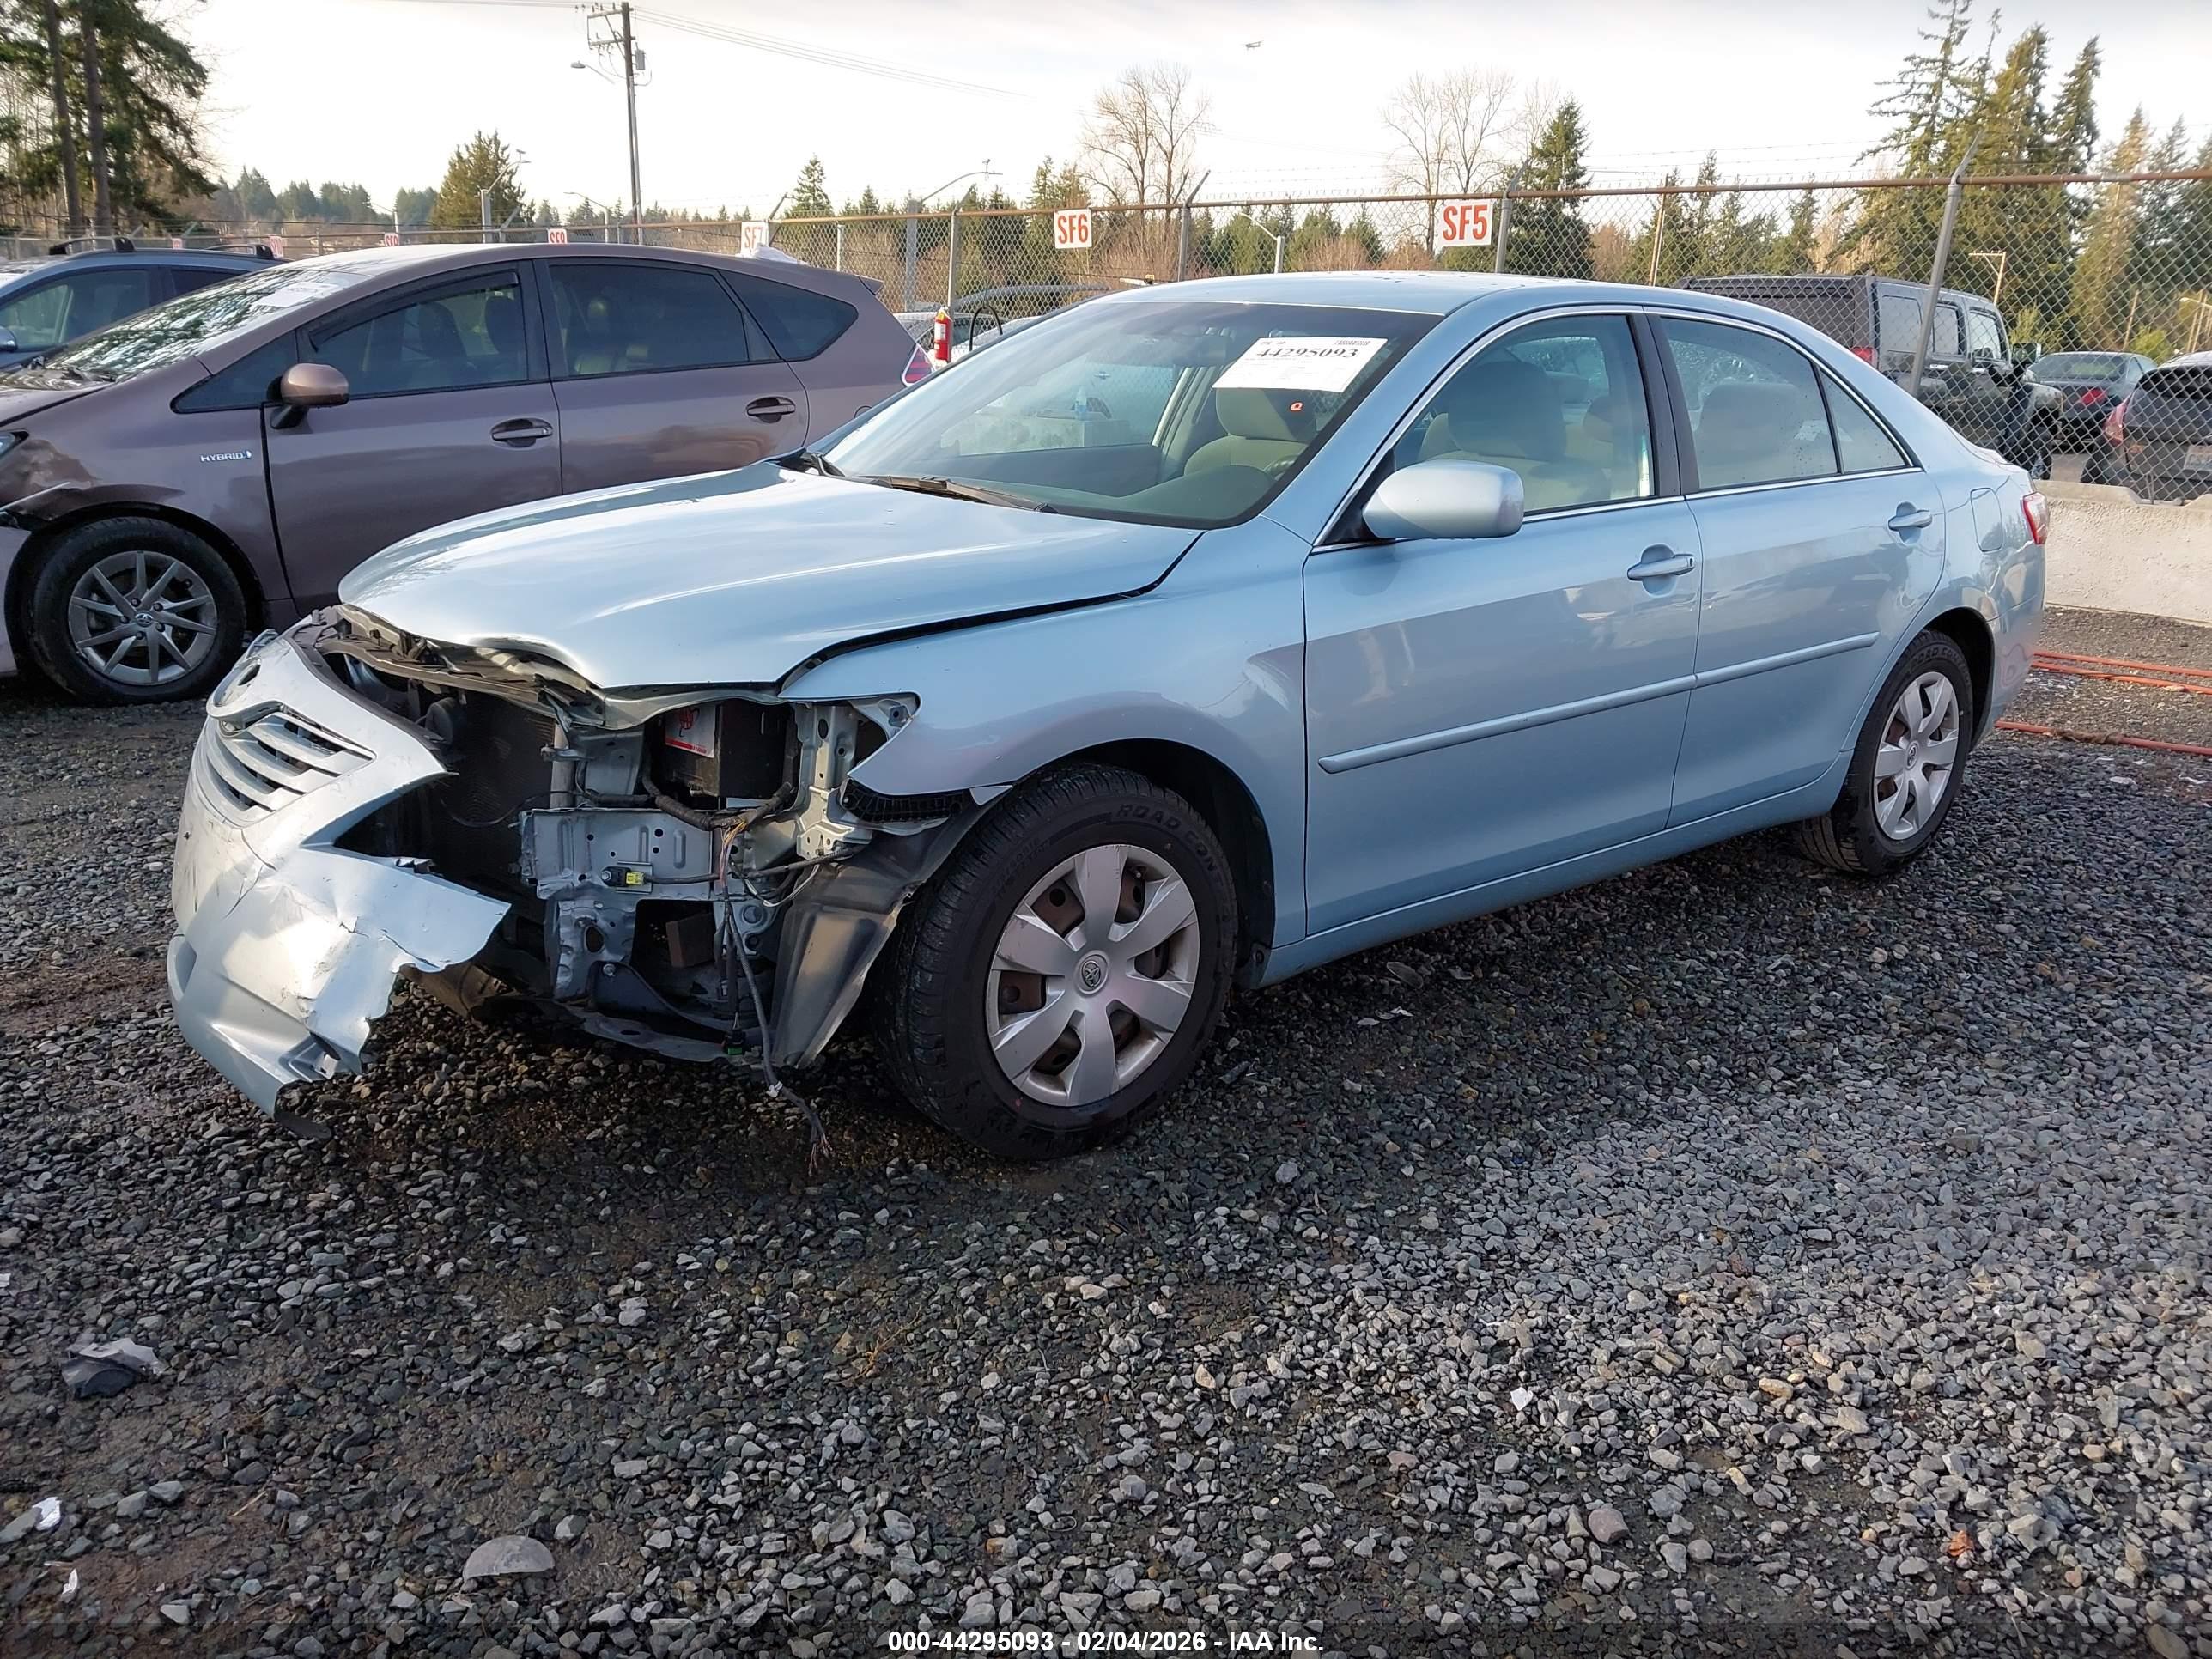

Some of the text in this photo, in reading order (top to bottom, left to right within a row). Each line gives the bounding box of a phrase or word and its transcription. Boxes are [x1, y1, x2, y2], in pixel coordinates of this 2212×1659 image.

[1057, 213, 1089, 244] SF6
[1443, 204, 1487, 241] SF5
[744, 226, 763, 249] SF7
[1256, 348, 1359, 358] 44295093
[200, 452, 245, 462] HYBRID
